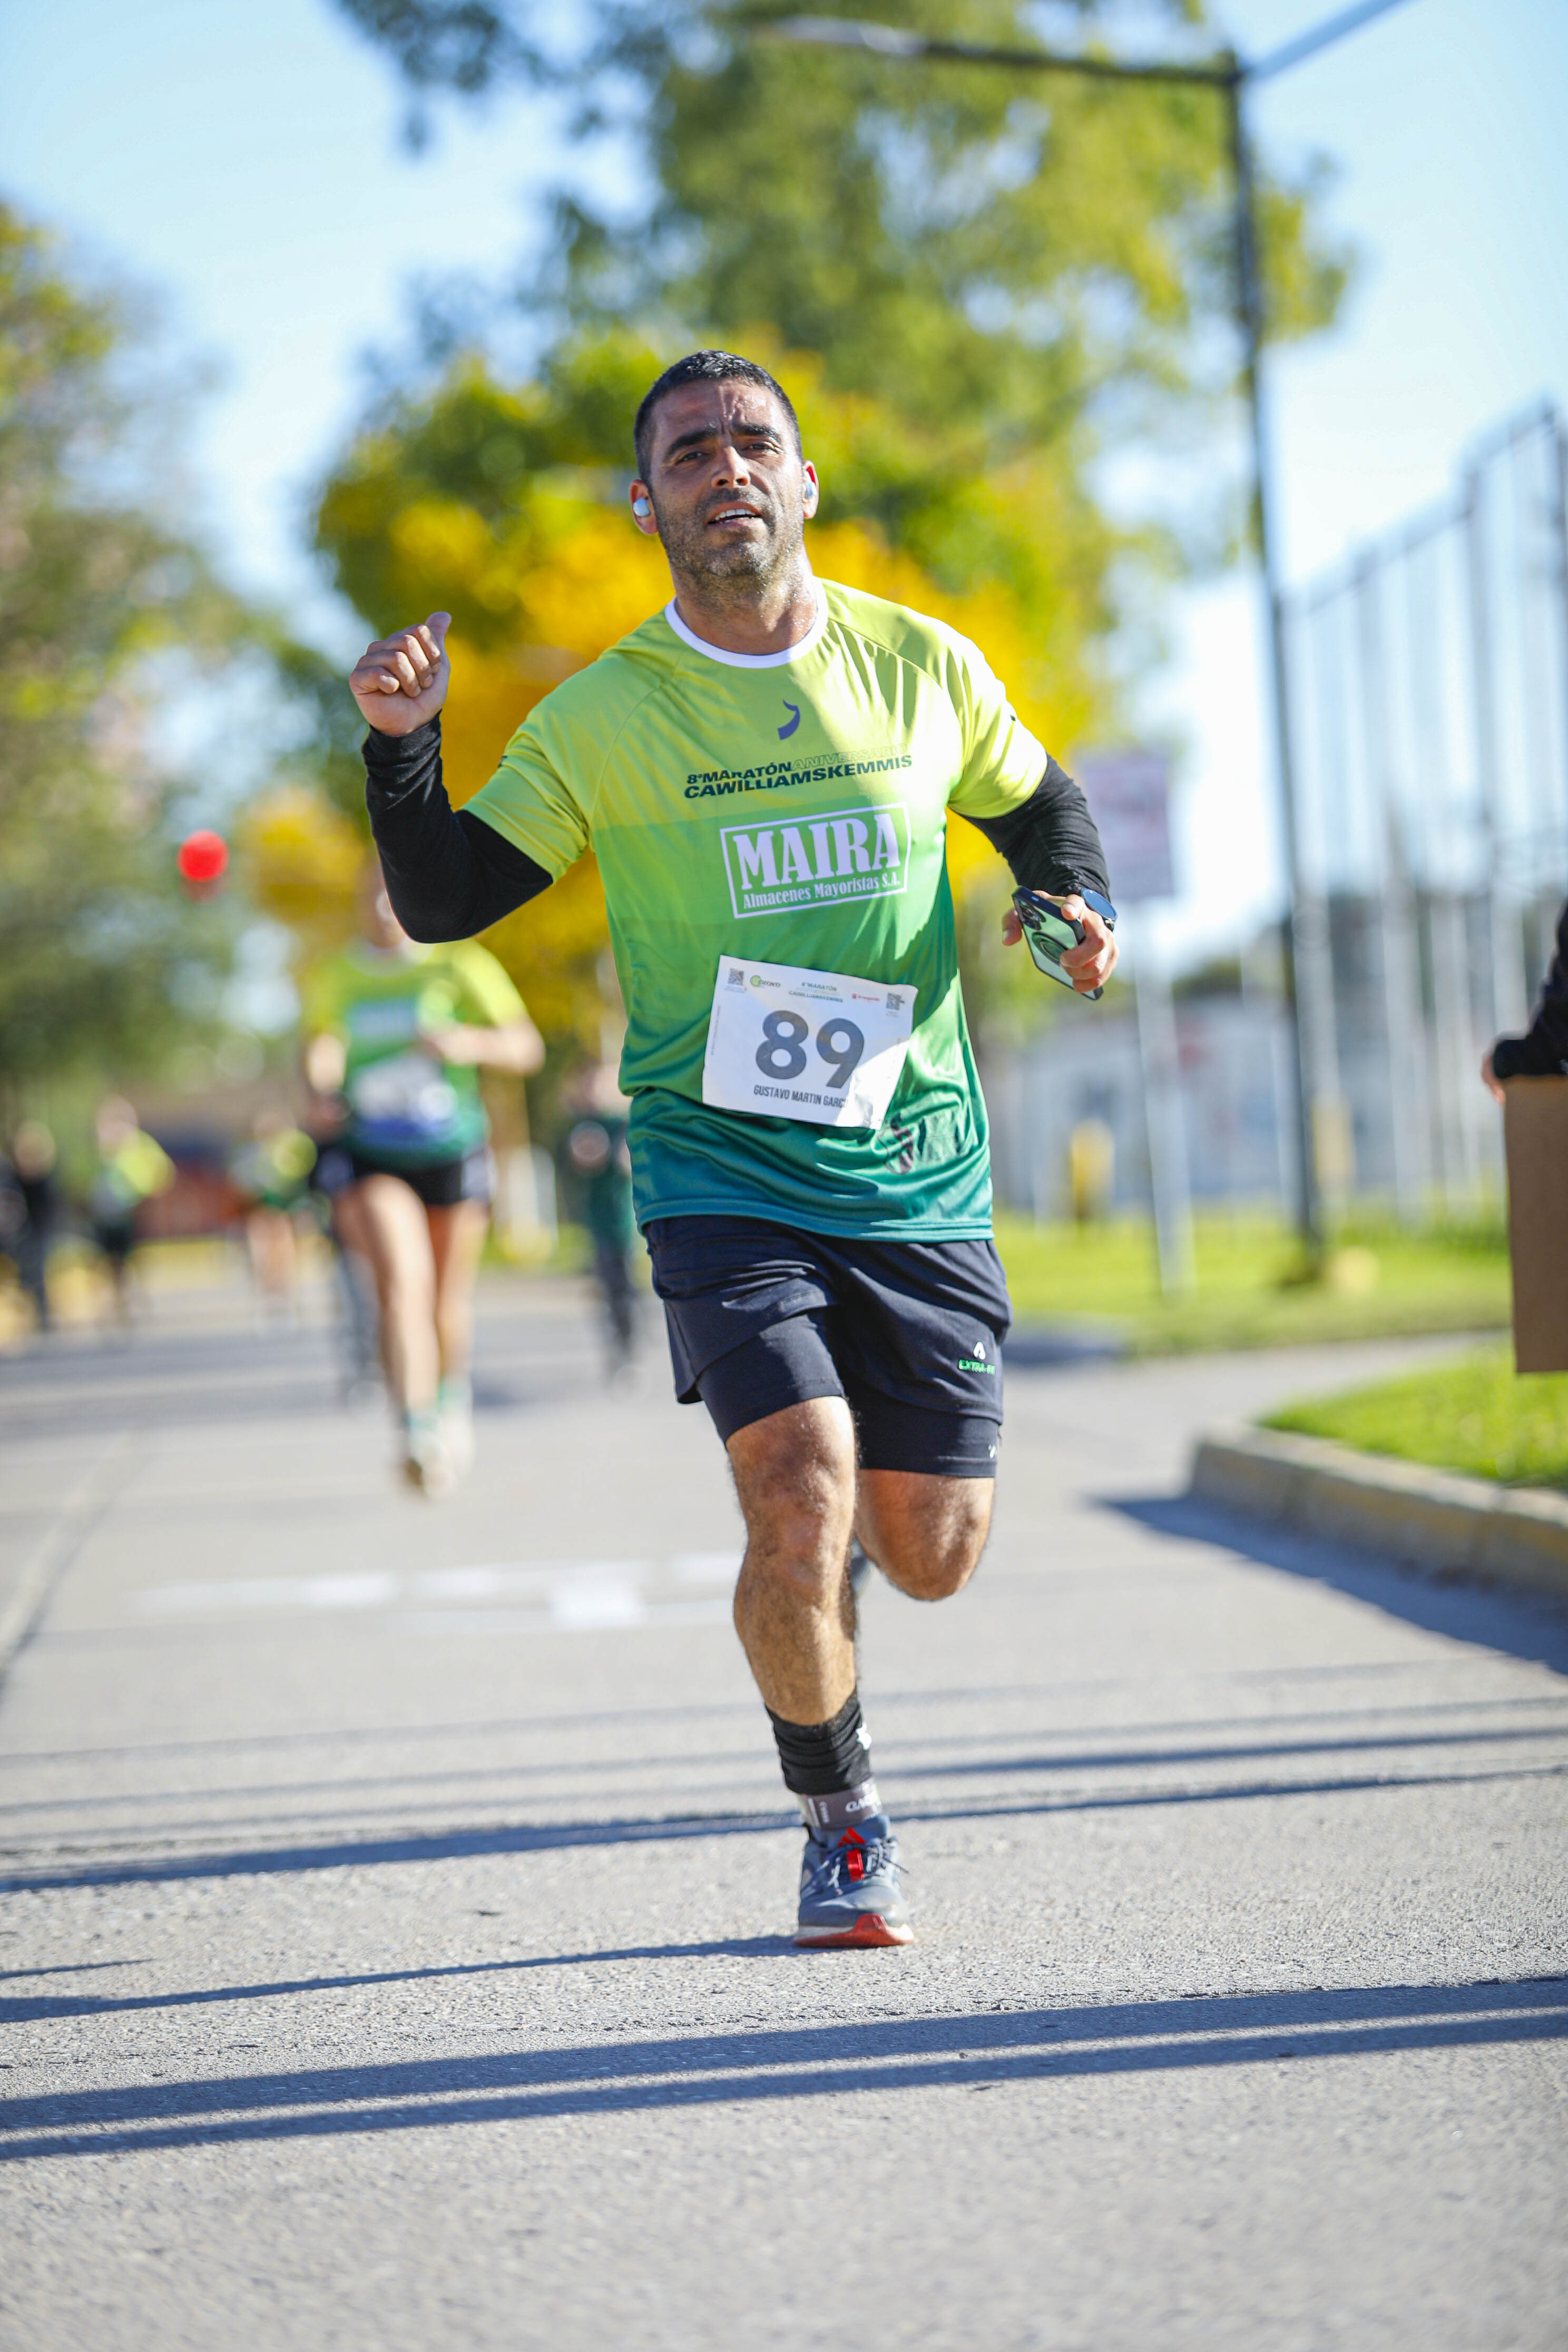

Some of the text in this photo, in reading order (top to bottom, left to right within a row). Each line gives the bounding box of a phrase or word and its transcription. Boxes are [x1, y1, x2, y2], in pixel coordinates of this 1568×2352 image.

[684, 754, 912, 798] CAWILLIAMSKEMMIS
[733, 814, 900, 890] MAIRA
[743, 871, 900, 909] Almacenes Mayoristas S.A.
[755, 1010, 865, 1089] 89
[753, 1084, 790, 1100] GUSTAVO
[791, 1091, 821, 1105] MARTIN
